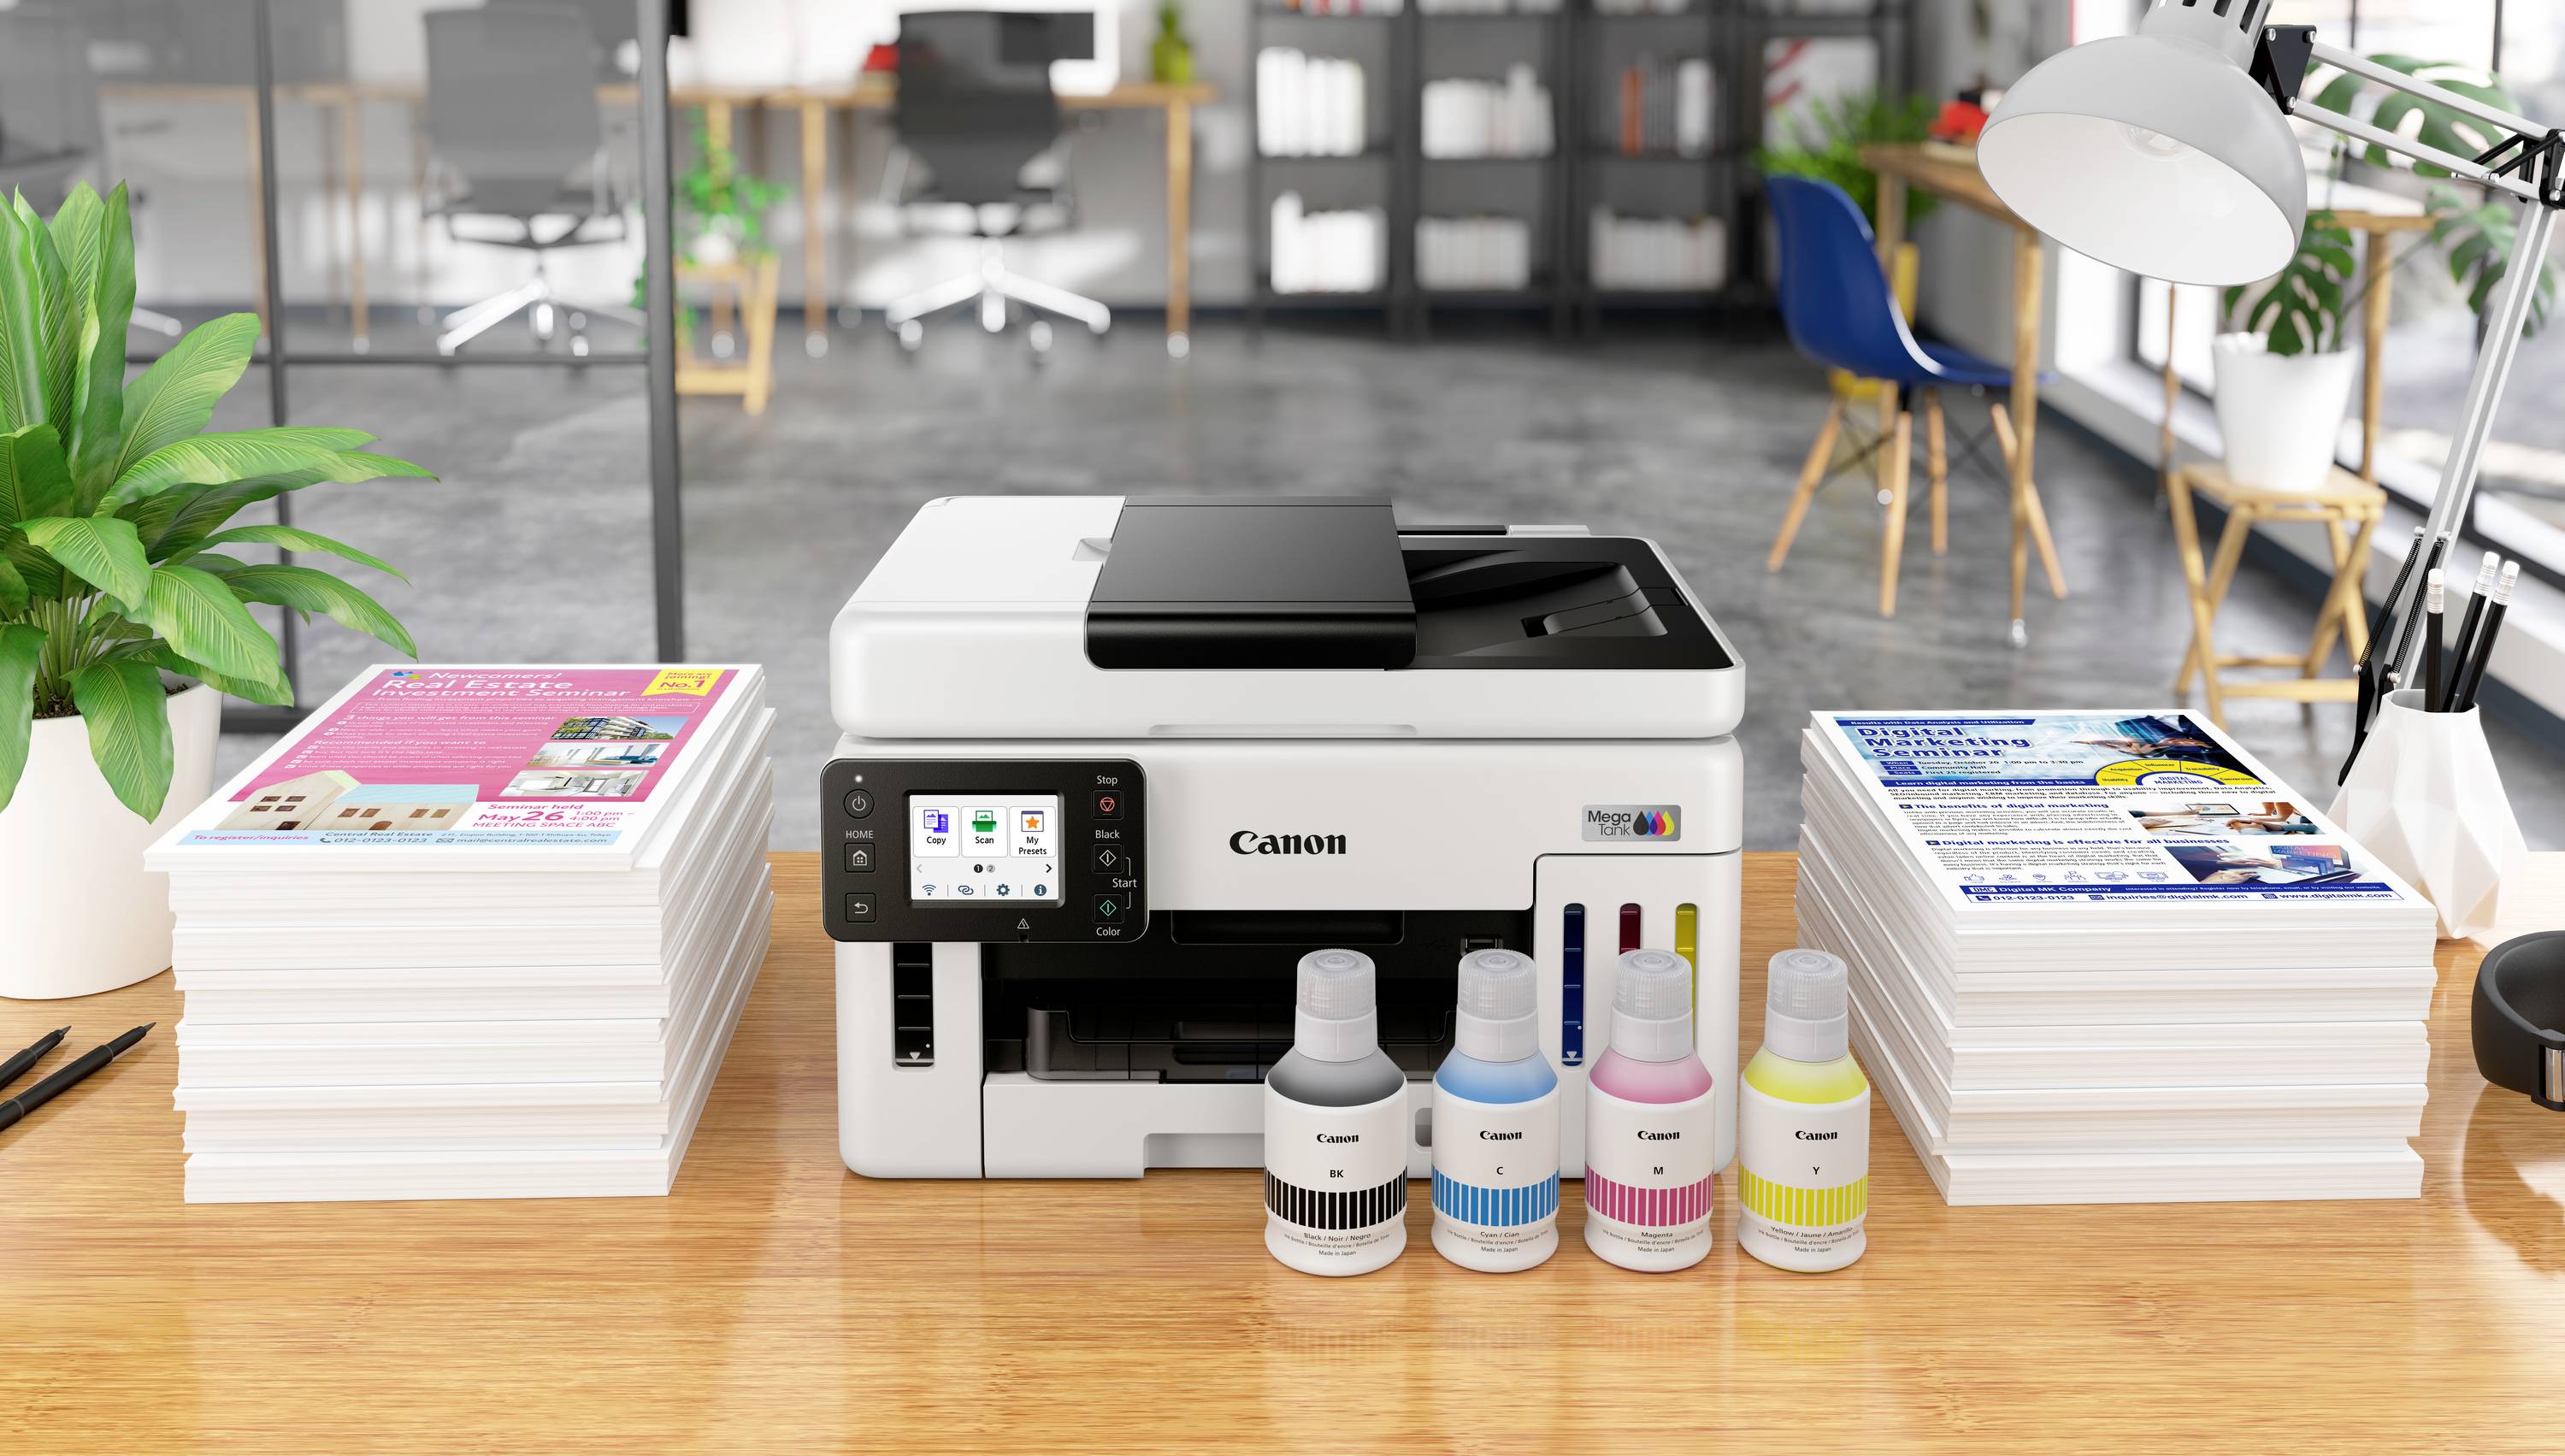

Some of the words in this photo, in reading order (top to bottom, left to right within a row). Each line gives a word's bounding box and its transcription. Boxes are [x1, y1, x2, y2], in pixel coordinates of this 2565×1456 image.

[382, 680, 457, 689] Real
[464, 680, 573, 689] Estate
[1856, 728, 1965, 738] Digital
[1864, 737, 2031, 747] Marketing
[1872, 748, 2002, 757] Seminar
[1096, 775, 1117, 787] Stop
[522, 811, 565, 821] 26
[1588, 810, 1631, 826] Mega
[1095, 829, 1120, 840] Black
[1598, 823, 1630, 836] Tank
[846, 830, 874, 840] HOME
[926, 836, 946, 846] Copy
[975, 836, 994, 845] Scan
[1026, 836, 1039, 846] My
[1229, 830, 1347, 855] Canon
[1018, 847, 1047, 856] Presets
[1112, 878, 1137, 888] Start
[1096, 927, 1121, 937] Color
[1316, 1134, 1359, 1143] Canon
[1479, 1130, 1523, 1141] Canon
[1637, 1130, 1680, 1141] Canon
[1795, 1130, 1838, 1141] Canon
[1330, 1170, 1344, 1178] BK
[1496, 1166, 1503, 1176] C
[1771, 1226, 1795, 1236] Yellow
[1304, 1232, 1322, 1241] Black
